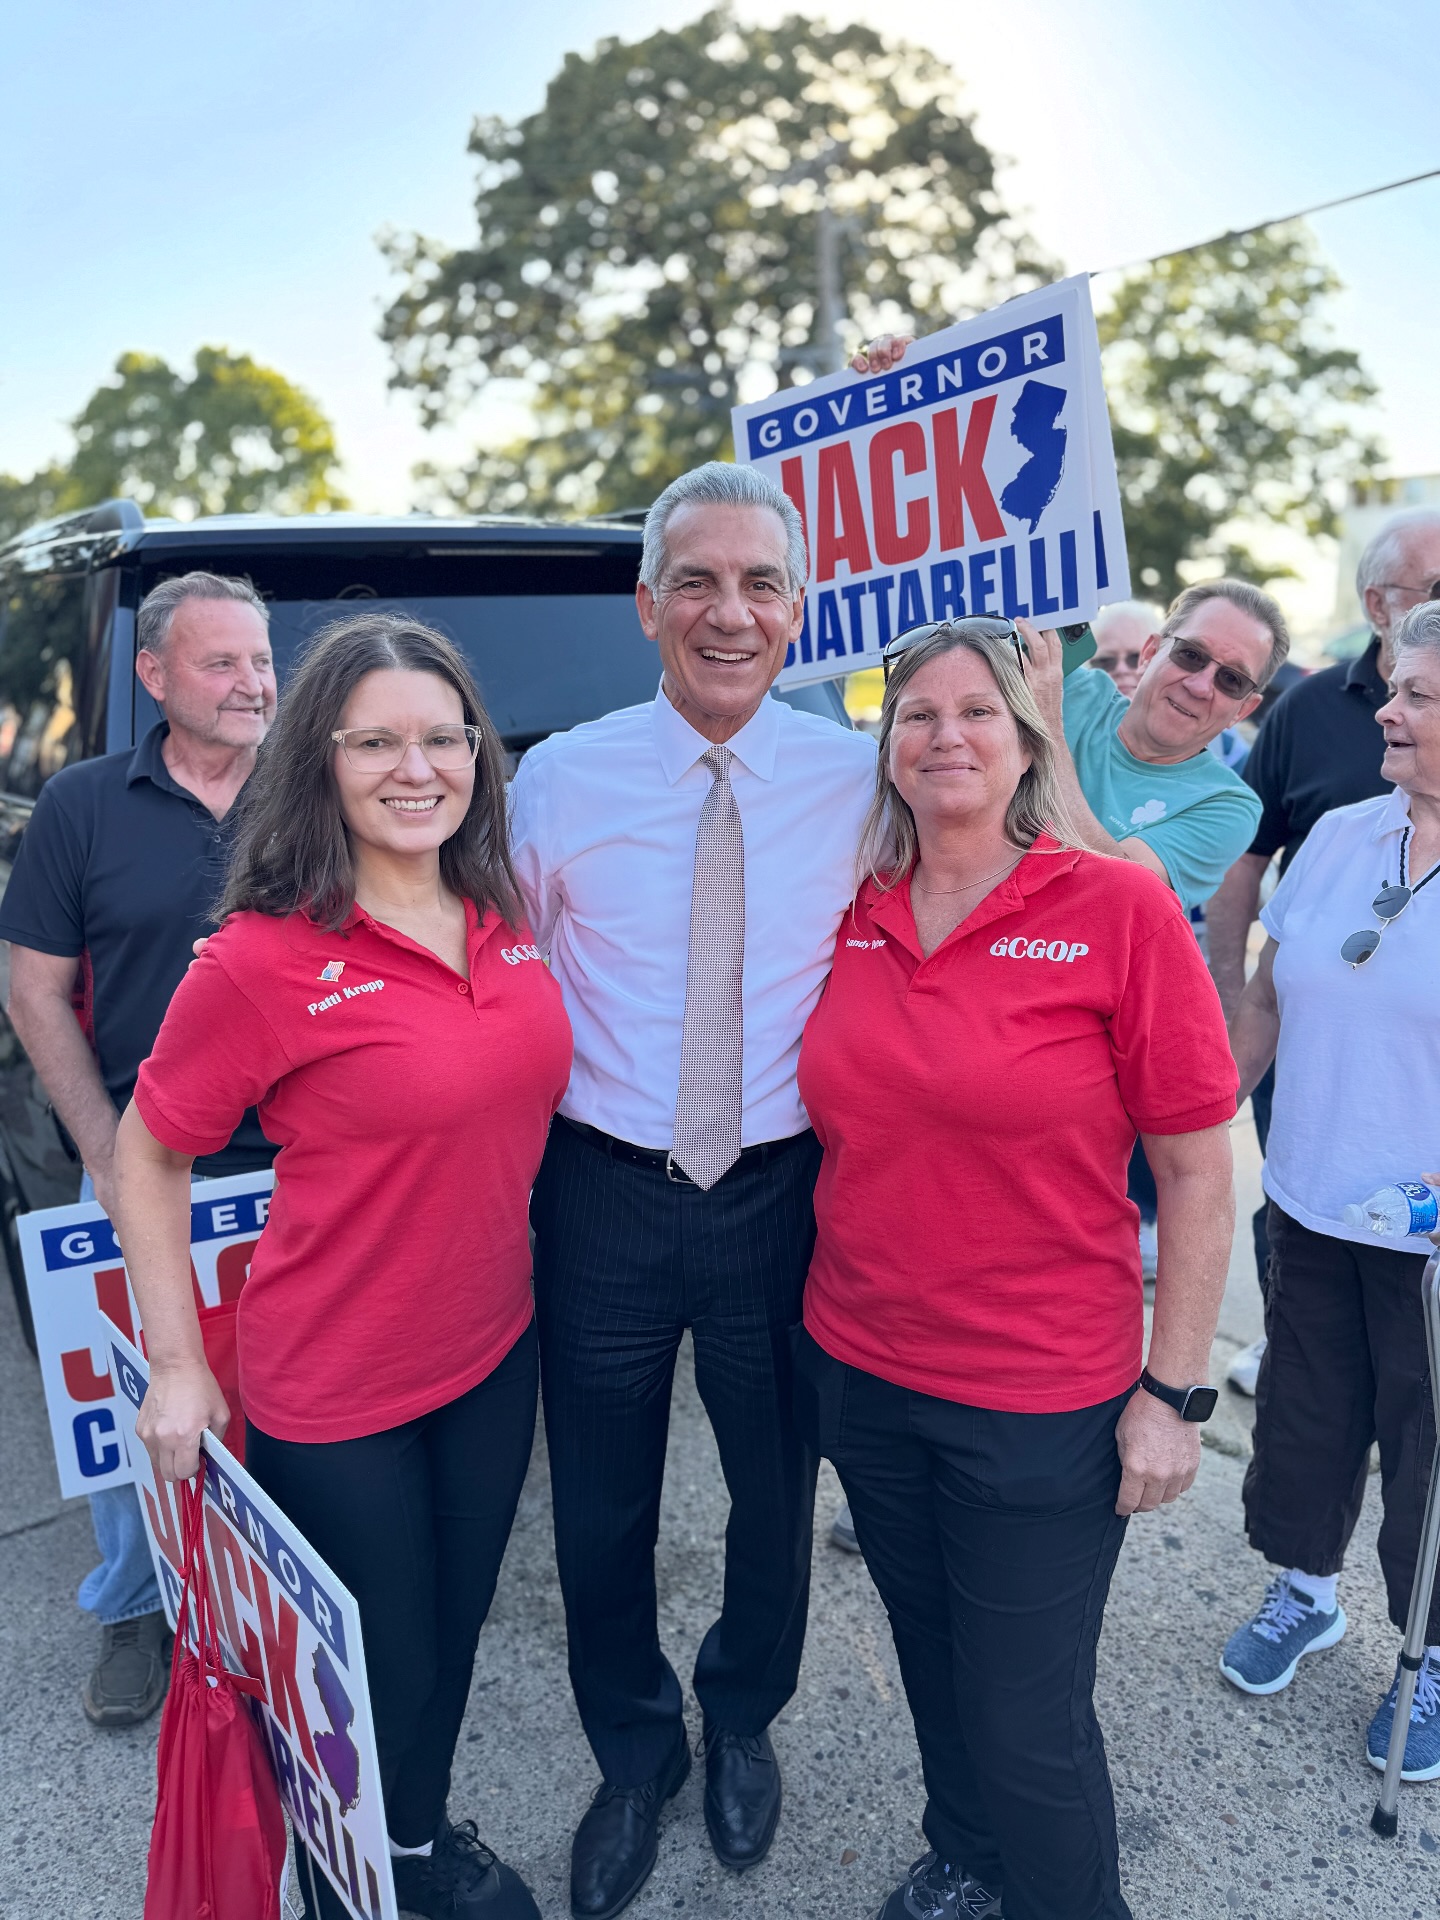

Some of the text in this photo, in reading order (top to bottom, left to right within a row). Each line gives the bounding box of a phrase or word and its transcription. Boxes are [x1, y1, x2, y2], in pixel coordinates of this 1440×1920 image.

[758, 331, 1050, 449] GOVERNOR
[783, 530, 1079, 669] IATTARELLI
[989, 937, 1090, 963] GCGOP
[307, 979, 385, 1016] Patti Kropp
